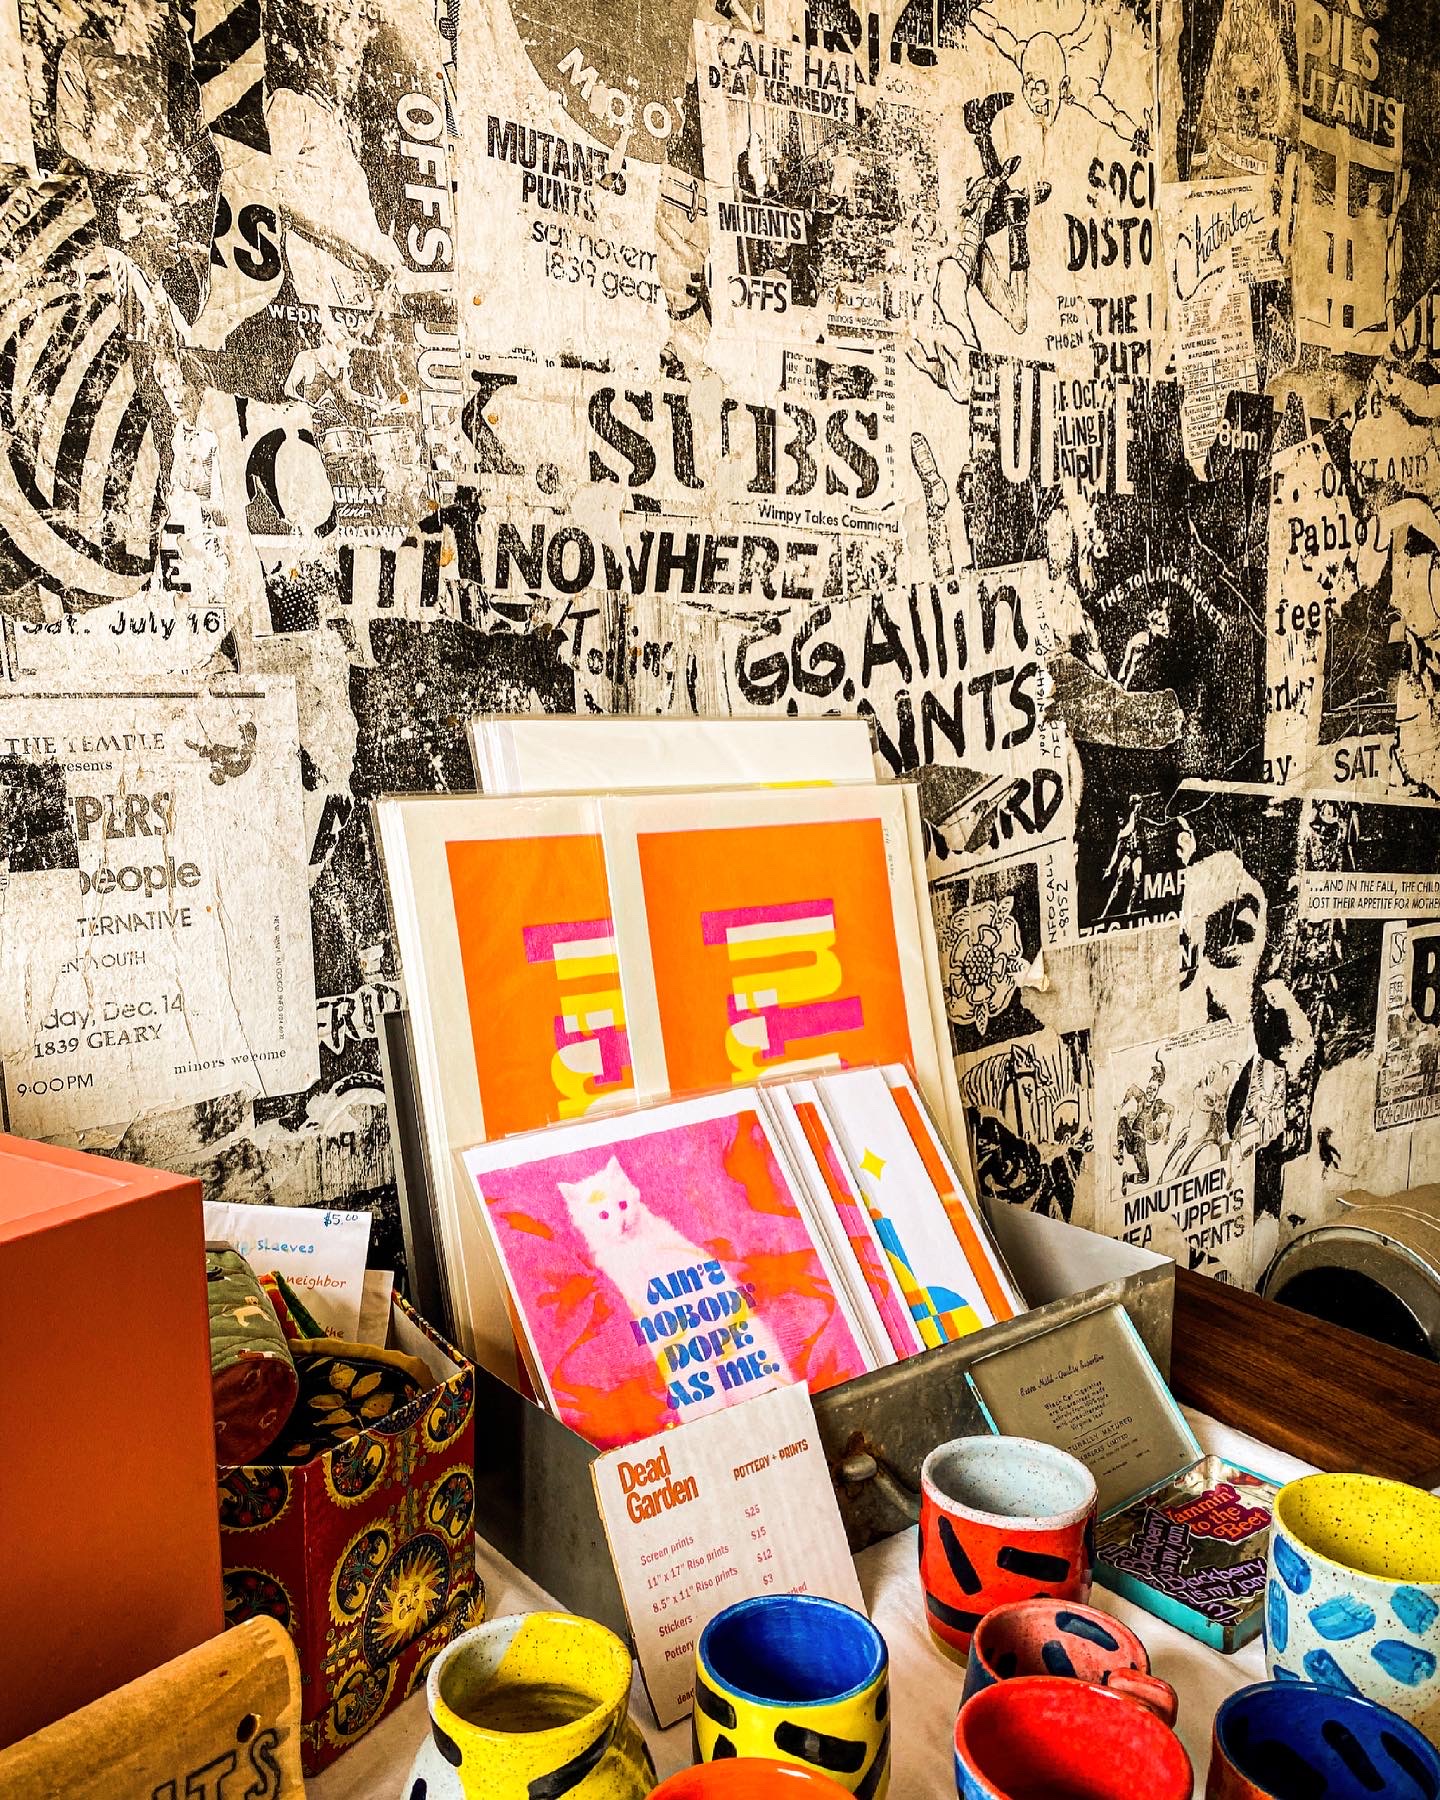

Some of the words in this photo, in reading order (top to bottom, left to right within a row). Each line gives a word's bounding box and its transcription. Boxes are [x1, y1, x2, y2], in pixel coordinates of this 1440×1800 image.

[764, 78, 850, 117] KENNEDYS
[396, 91, 455, 267] OFFS
[719, 203, 803, 240] MUTANTS
[1063, 213, 1153, 272] DISTO
[1172, 201, 1266, 301] Chatterbox
[727, 274, 789, 314] OFFS
[1087, 294, 1138, 336] THE
[1218, 418, 1259, 451] 8pm
[757, 503, 801, 525] Wimpy
[805, 509, 839, 527] Takes
[842, 514, 899, 534] Command
[1288, 513, 1369, 557] Pablo
[493, 522, 820, 601] NOWHERE
[1097, 583, 1125, 612] THE
[1126, 565, 1179, 592] TOILING
[109, 610, 176, 641] July
[187, 611, 221, 636] 16
[4, 736, 58, 756] THE
[63, 732, 166, 754] TEMPLE
[60, 761, 114, 773] resents
[1333, 744, 1381, 783] SAT.
[1045, 854, 1056, 902] CALL
[1346, 879, 1358, 893] IN
[1360, 880, 1375, 893] THE
[1376, 880, 1398, 896] FALL,
[1401, 881, 1416, 893] THE
[1308, 896, 1329, 909] LOST
[1332, 897, 1355, 909] THEIR
[1357, 897, 1393, 910] APPETITE
[1394, 897, 1410, 910] FOR
[77, 907, 193, 938] TERNATIVE
[103, 1000, 158, 1023] Dec.
[161, 993, 185, 1014] 14
[33, 1036, 80, 1060] 1839
[86, 1022, 164, 1050] GEARY
[173, 1057, 226, 1076] minors
[230, 1047, 288, 1066] wecome
[323, 1211, 360, 1228] $5.00
[285, 1274, 348, 1291] neighbor
[663, 1320, 755, 1374] DOPE
[666, 1370, 716, 1411] AS
[715, 1349, 781, 1392] ME.
[1101, 1416, 1134, 1435] MATURED
[617, 1446, 673, 1495] Dead
[733, 1456, 771, 1482] POTTERY
[778, 1438, 810, 1461] PRINTS
[626, 1474, 700, 1525] Garden
[744, 1504, 761, 1520] $25
[751, 1526, 767, 1541] $15
[1191, 1520, 1211, 1534] to
[1208, 1504, 1242, 1526] the
[1212, 1510, 1270, 1540] Beet
[640, 1543, 669, 1567] Screen
[670, 1535, 695, 1556] prints
[687, 1554, 706, 1572] Riso
[706, 1544, 731, 1566] prints
[757, 1548, 774, 1564] $12
[695, 1576, 715, 1594] Riso
[715, 1566, 739, 1588] prints
[763, 1573, 775, 1587] $3
[1156, 1559, 1267, 1592] Blackberry
[658, 1614, 694, 1639] Stickers
[664, 1639, 695, 1663] Pottery
